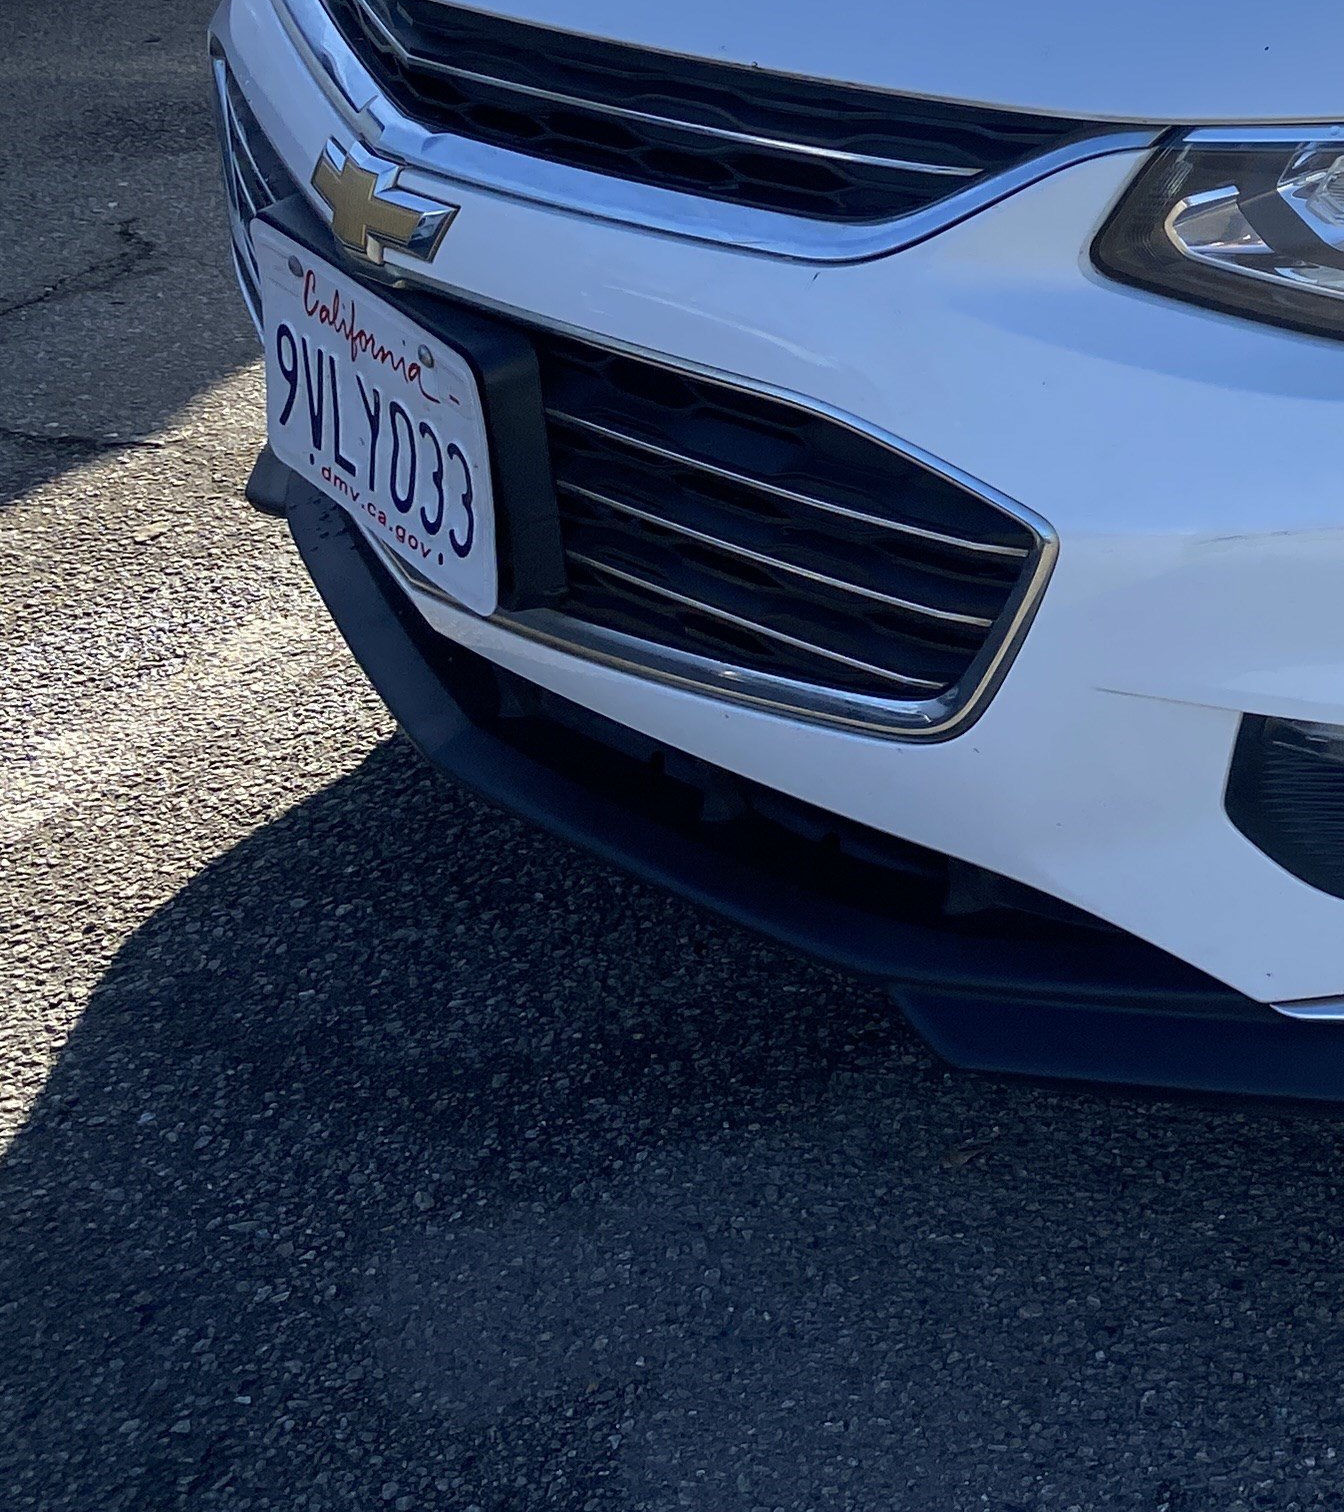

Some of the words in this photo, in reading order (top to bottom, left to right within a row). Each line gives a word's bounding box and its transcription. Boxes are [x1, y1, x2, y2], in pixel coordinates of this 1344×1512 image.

[302, 269, 440, 404] California
[276, 323, 474, 559] 9VLY033
[321, 465, 432, 561] dmv.ca.gov
